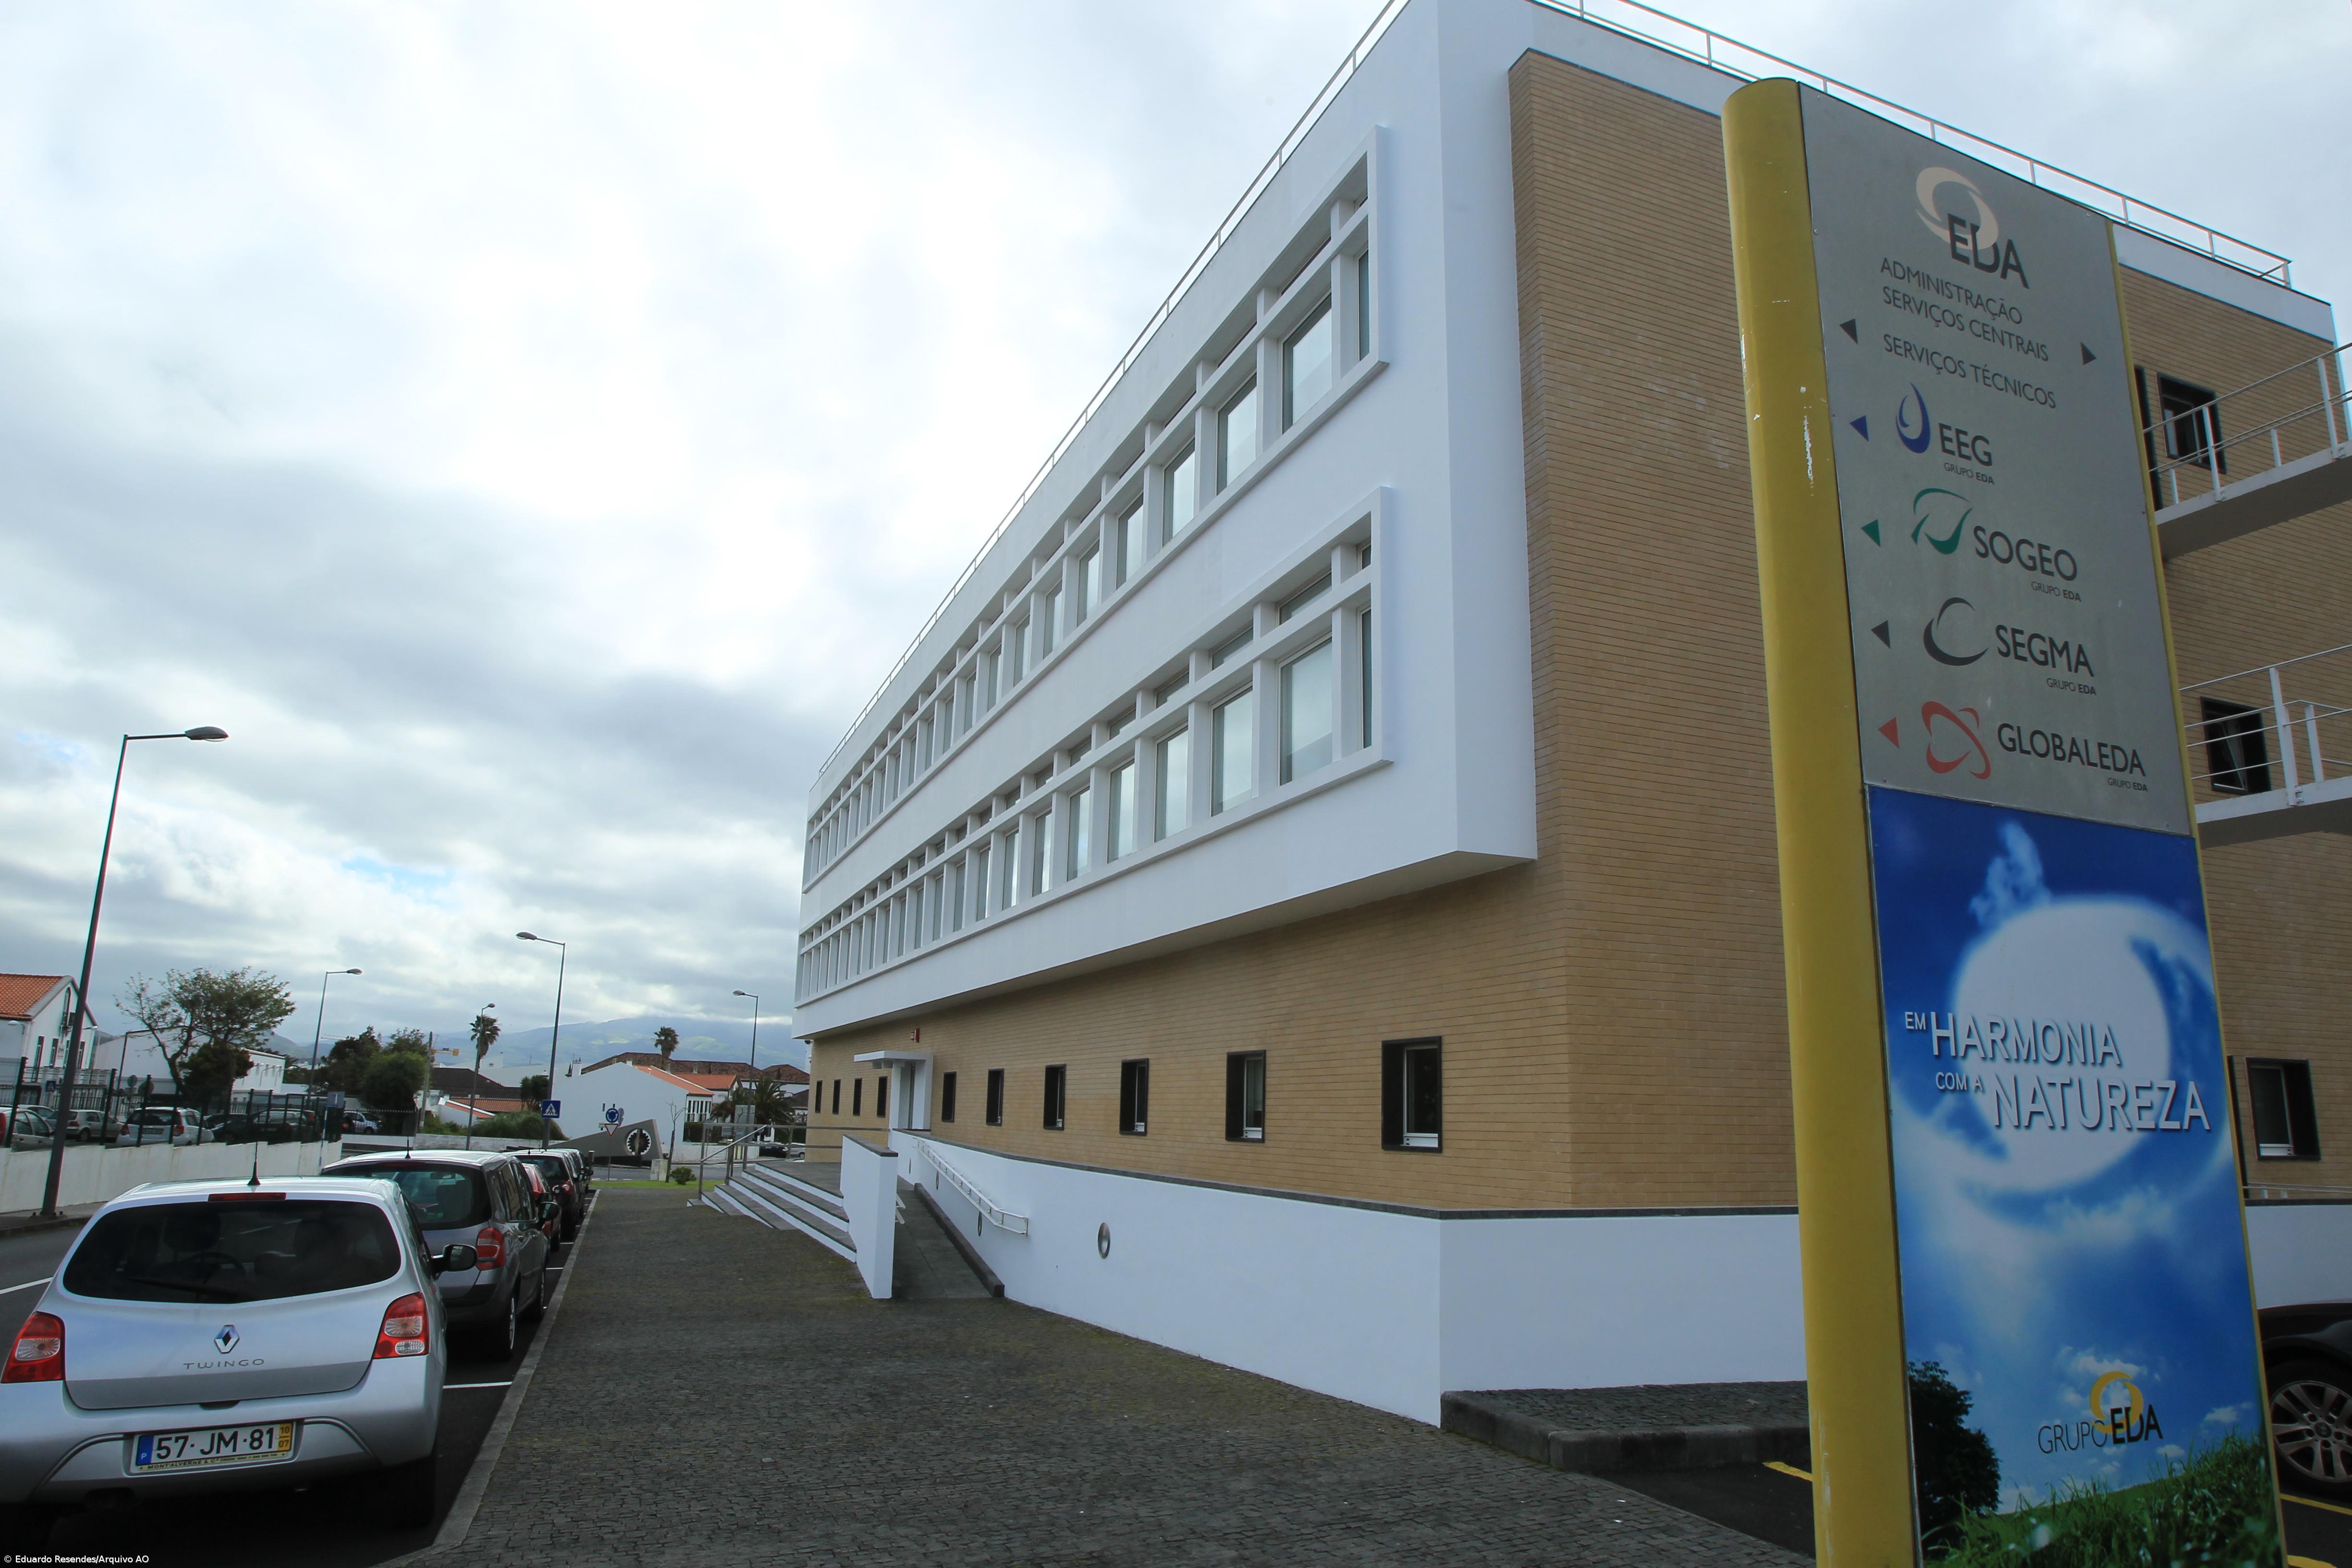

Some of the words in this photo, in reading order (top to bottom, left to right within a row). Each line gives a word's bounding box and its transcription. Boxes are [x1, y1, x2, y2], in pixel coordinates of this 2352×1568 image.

[1947, 213, 2029, 289] EDA
[1881, 257, 2022, 325] ADMINISTRAÇÃO
[1883, 286, 1965, 331] SERVIÇOS
[1969, 319, 2048, 362] CENTRAIS
[1883, 333, 1966, 378] SERVIÇOS
[1969, 364, 2056, 409] TÉCNICOS
[1938, 422, 1993, 466] EEG
[1944, 462, 1973, 478] GRUPO
[1975, 472, 1995, 485] EDA
[1973, 525, 2077, 581] SOGEO
[2031, 581, 2060, 596] GRUPO
[2062, 589, 2082, 602] EDA
[1995, 624, 2095, 677] SEGMA
[2046, 678, 2076, 692] GRUPO
[2078, 684, 2097, 696] EDA
[1997, 723, 2146, 777] GLOBALEDA
[2107, 777, 2131, 789] GRUPO
[2132, 782, 2148, 792] EDA
[1905, 1011, 1926, 1030] EM
[1930, 1011, 2122, 1065] HARMONIA
[1936, 1071, 1967, 1090] COM
[1973, 1075, 1984, 1091] A
[1993, 1072, 2211, 1131] NATUREZA
[183, 1359, 265, 1370] TWINGO
[278, 1439, 289, 1447] 07
[280, 1425, 290, 1434] 10
[2038, 1420, 2107, 1454] GRUPO
[2110, 1403, 2164, 1445] EDA
